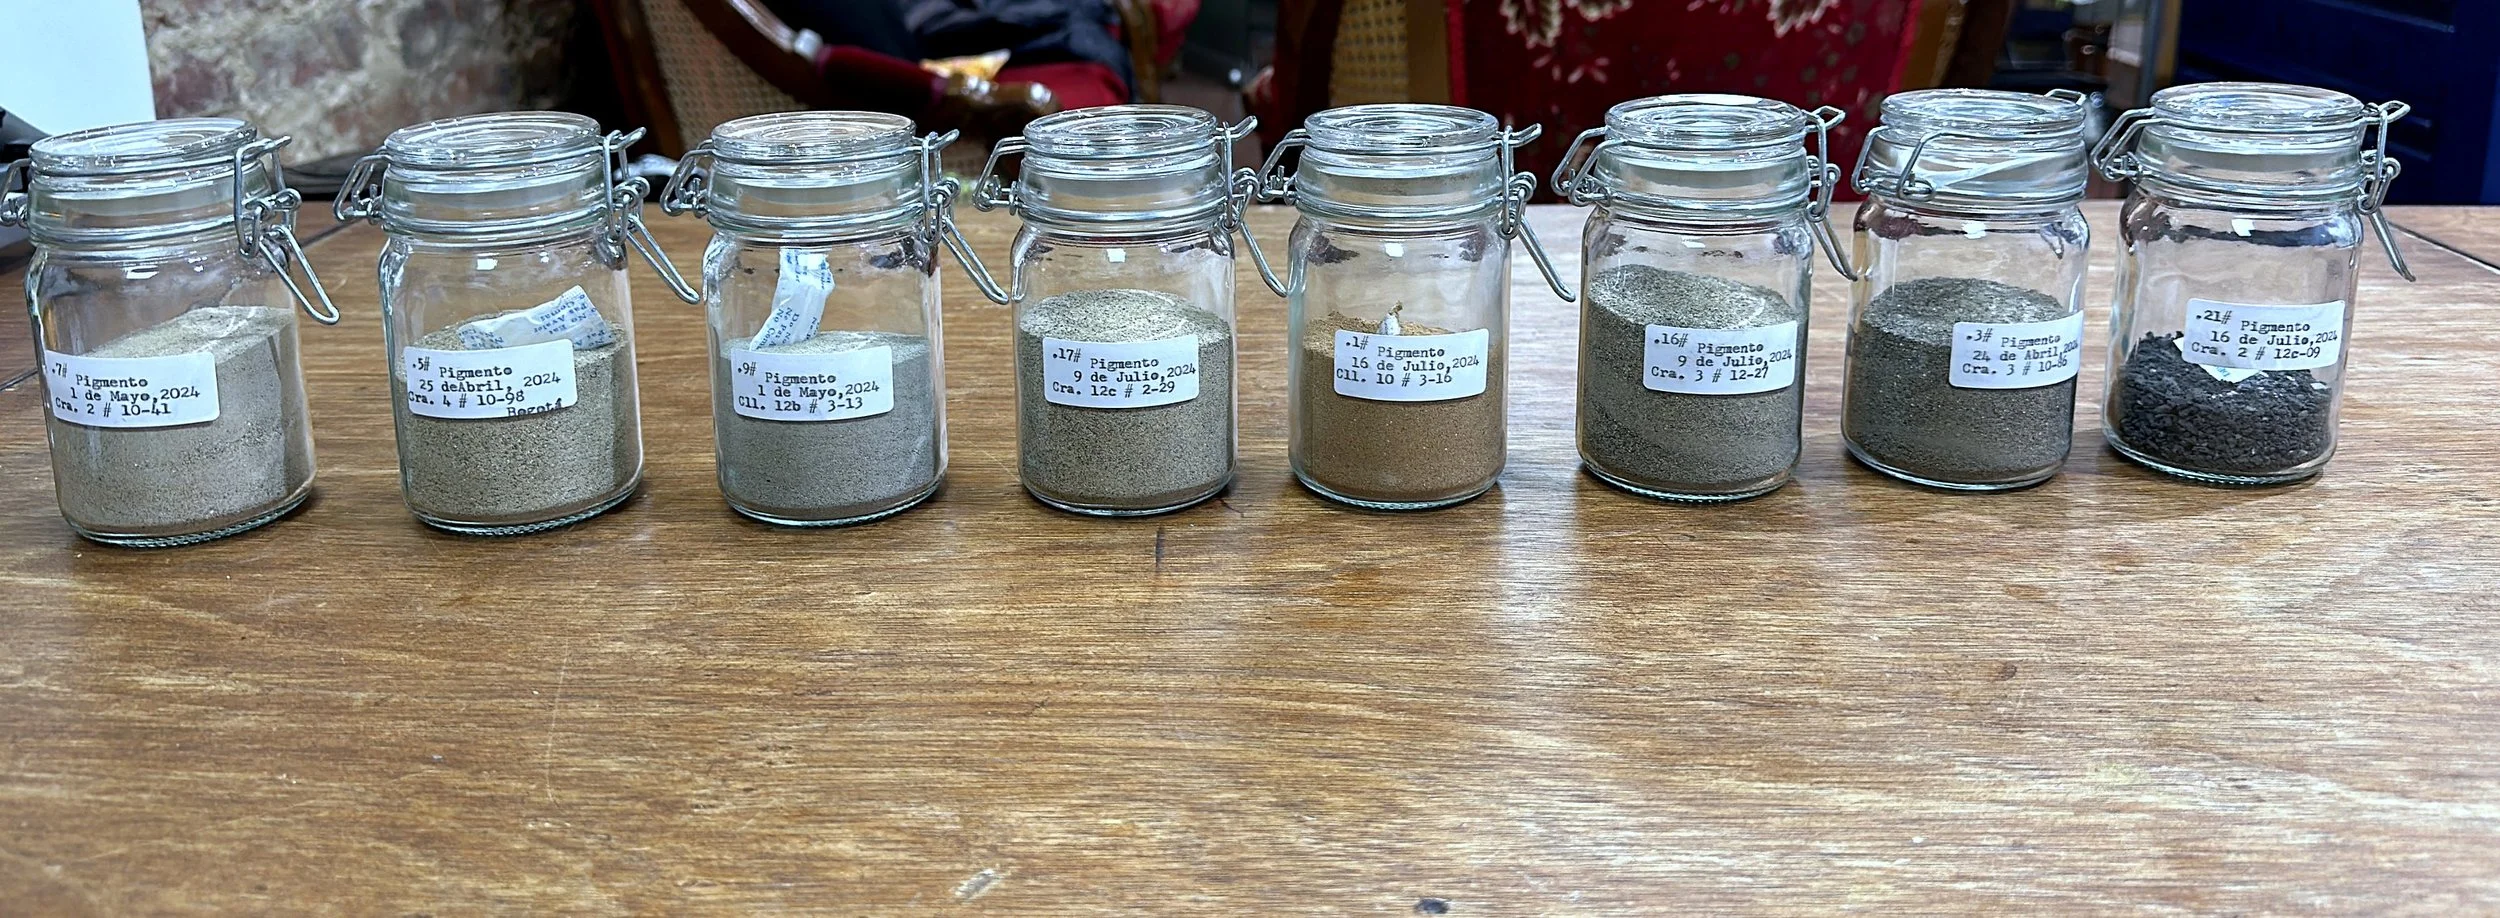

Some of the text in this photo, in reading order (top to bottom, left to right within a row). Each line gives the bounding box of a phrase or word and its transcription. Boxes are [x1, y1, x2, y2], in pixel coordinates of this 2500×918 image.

[2195, 310, 2232, 325] .21#
[1966, 328, 1992, 342] .3#
[2240, 321, 2310, 334] Pigmento
[1346, 335, 1369, 350] .1#
[1654, 333, 1688, 348] .16#
[2001, 335, 2061, 349] Pigmento
[2210, 331, 2230, 342] 16
[2239, 335, 2258, 345] de
[1053, 348, 1081, 363] .17#
[1377, 346, 1445, 360] Pigmento
[1697, 342, 1764, 357] Pigmento
[1972, 351, 1991, 362] 24
[2000, 351, 2016, 361] de
[2191, 342, 2320, 360] Cra. 2 # 12c-09
[412, 356, 430, 371] .5#
[1090, 358, 1159, 371] Pigmento
[1352, 357, 1369, 369] 16
[1377, 361, 1394, 371] de
[1678, 355, 1687, 366] 9
[1696, 356, 1714, 366] de
[52, 363, 67, 377] .7#
[439, 366, 513, 380] Pigmento
[737, 361, 757, 376] .9#
[1651, 366, 1768, 383] Cra. 3 # 12-27
[1962, 363, 1996, 374] Cra.
[2006, 364, 2014, 375] 3
[2022, 361, 2031, 376] #
[76, 374, 148, 390] Pigmento
[419, 379, 433, 392] 25
[523, 372, 561, 387] 2024
[765, 372, 836, 386] Pigmento
[1074, 371, 1082, 382] 9
[1091, 372, 1107, 382] de
[1337, 369, 1452, 387] Cll. 10 # 3-16
[70, 387, 77, 399] 1
[85, 390, 101, 400] de
[758, 385, 765, 396] 1
[774, 386, 791, 397] de
[1053, 381, 1175, 398] Cra. 12c # 2-29
[408, 390, 525, 408] Cra. 4 # 10-98
[739, 395, 863, 413] Cll. 12b # 3-13
[56, 397, 171, 417] Cra. 2 # 10-41
